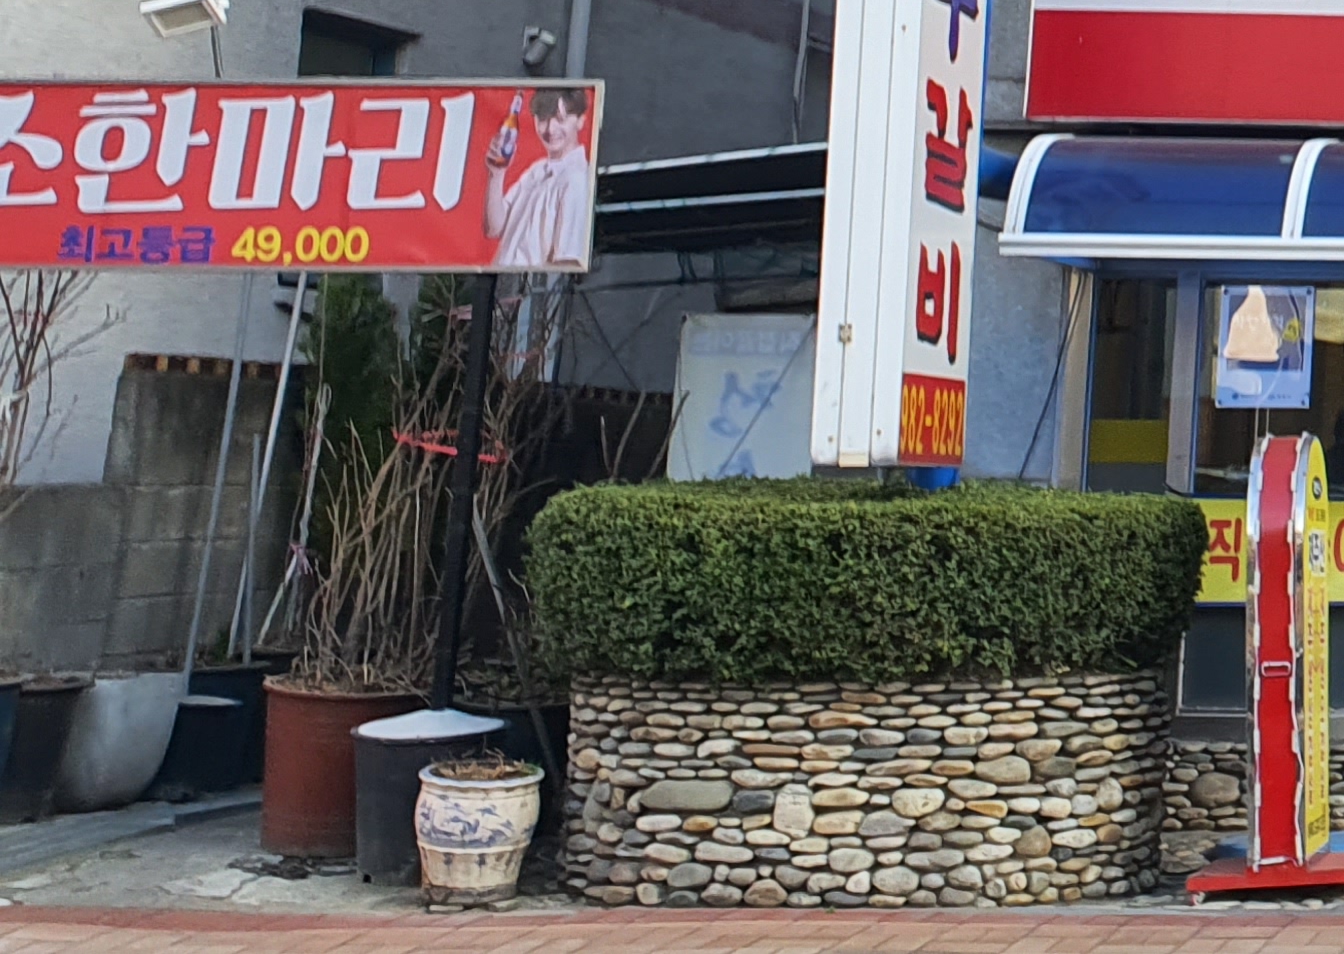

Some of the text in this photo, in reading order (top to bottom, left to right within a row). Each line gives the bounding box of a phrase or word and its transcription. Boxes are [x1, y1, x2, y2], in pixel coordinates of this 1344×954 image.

[57, 224, 370, 267] 최고등급 49,000
[900, 384, 964, 457] 982-8292
